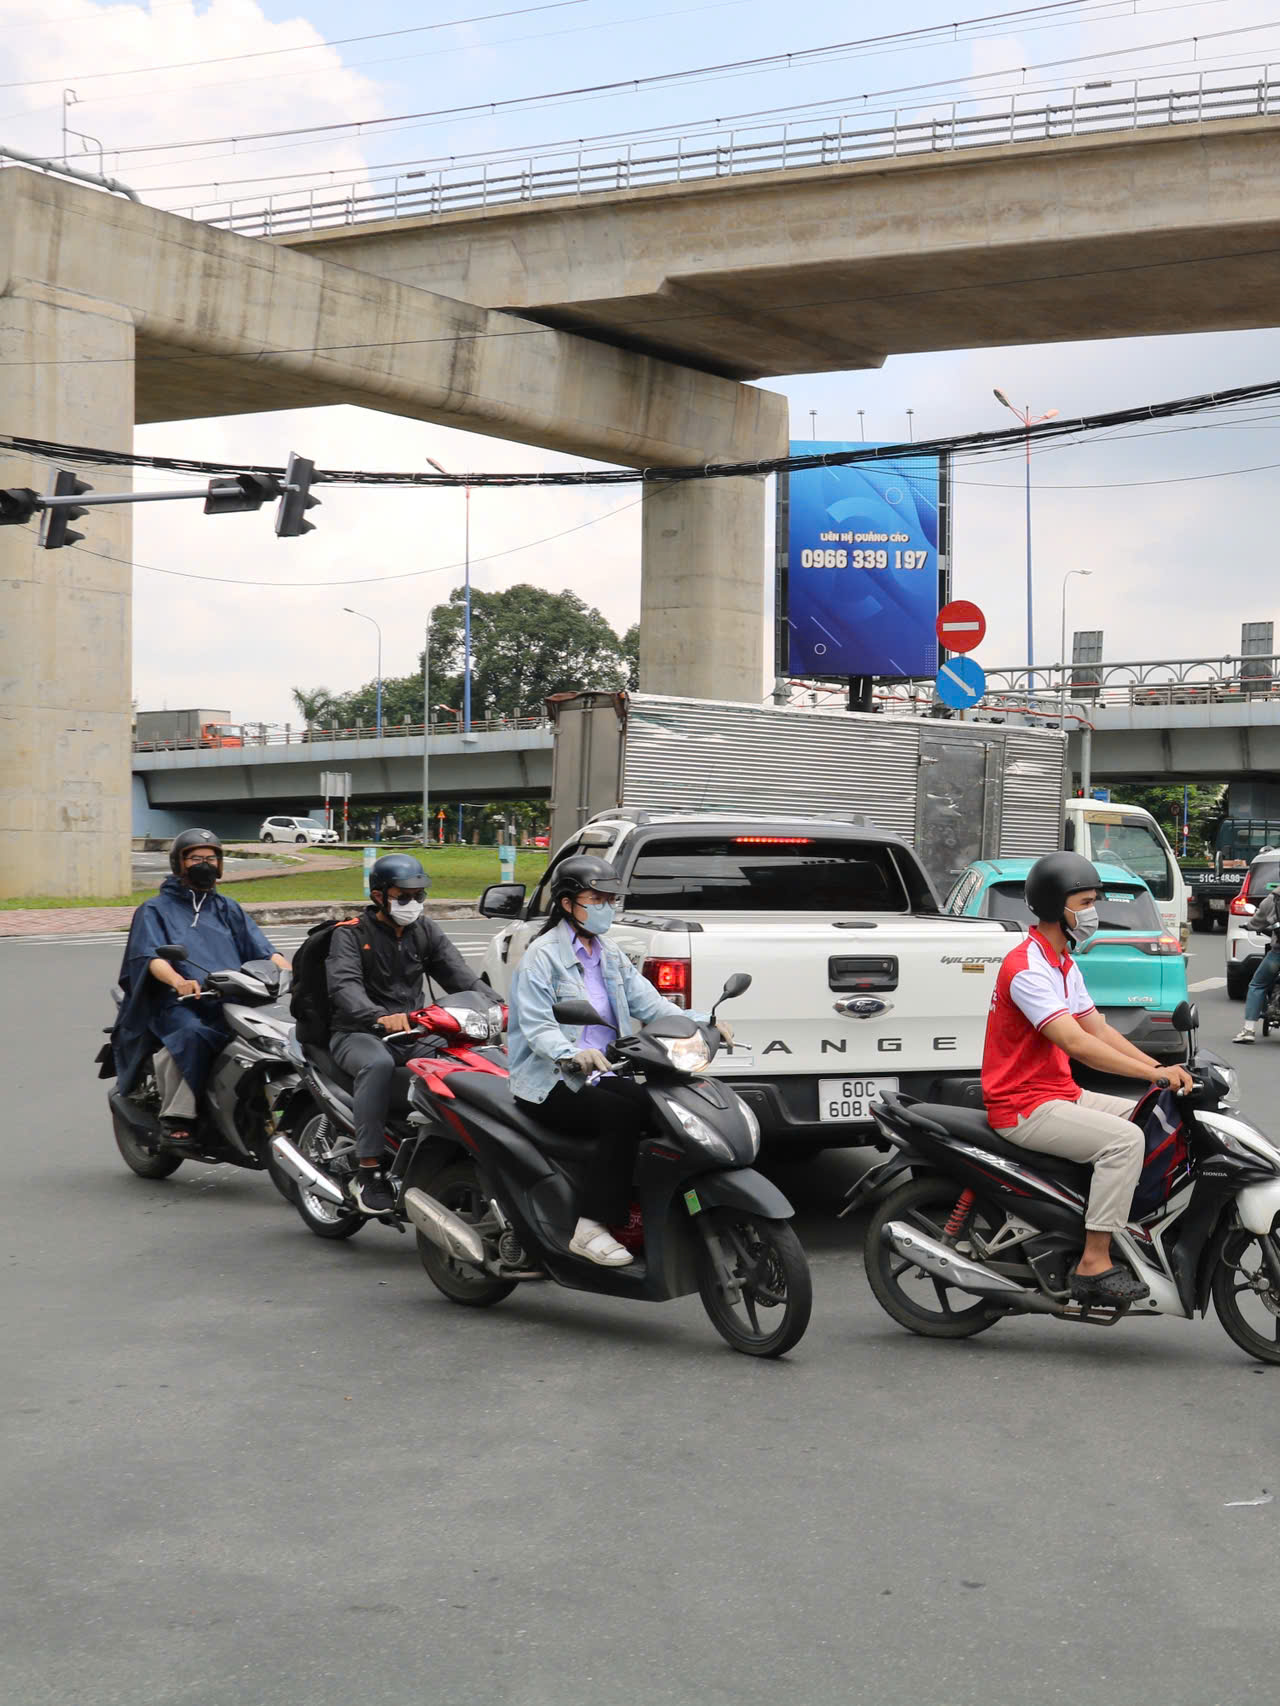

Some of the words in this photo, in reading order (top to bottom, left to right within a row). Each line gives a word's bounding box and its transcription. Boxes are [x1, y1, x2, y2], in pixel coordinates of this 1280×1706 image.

[820, 531, 840, 542] LIÊN
[841, 531, 854, 544] HỆ
[889, 531, 910, 543] CÁO
[801, 549, 848, 569] 0966
[852, 549, 888, 569] 339
[895, 549, 928, 569] 197
[940, 956, 1003, 964] WILDTRA
[855, 1001, 880, 1011] Ford
[718, 1036, 957, 1055] ANGE
[842, 1081, 876, 1098] 60C
[829, 1101, 878, 1118] 608.
